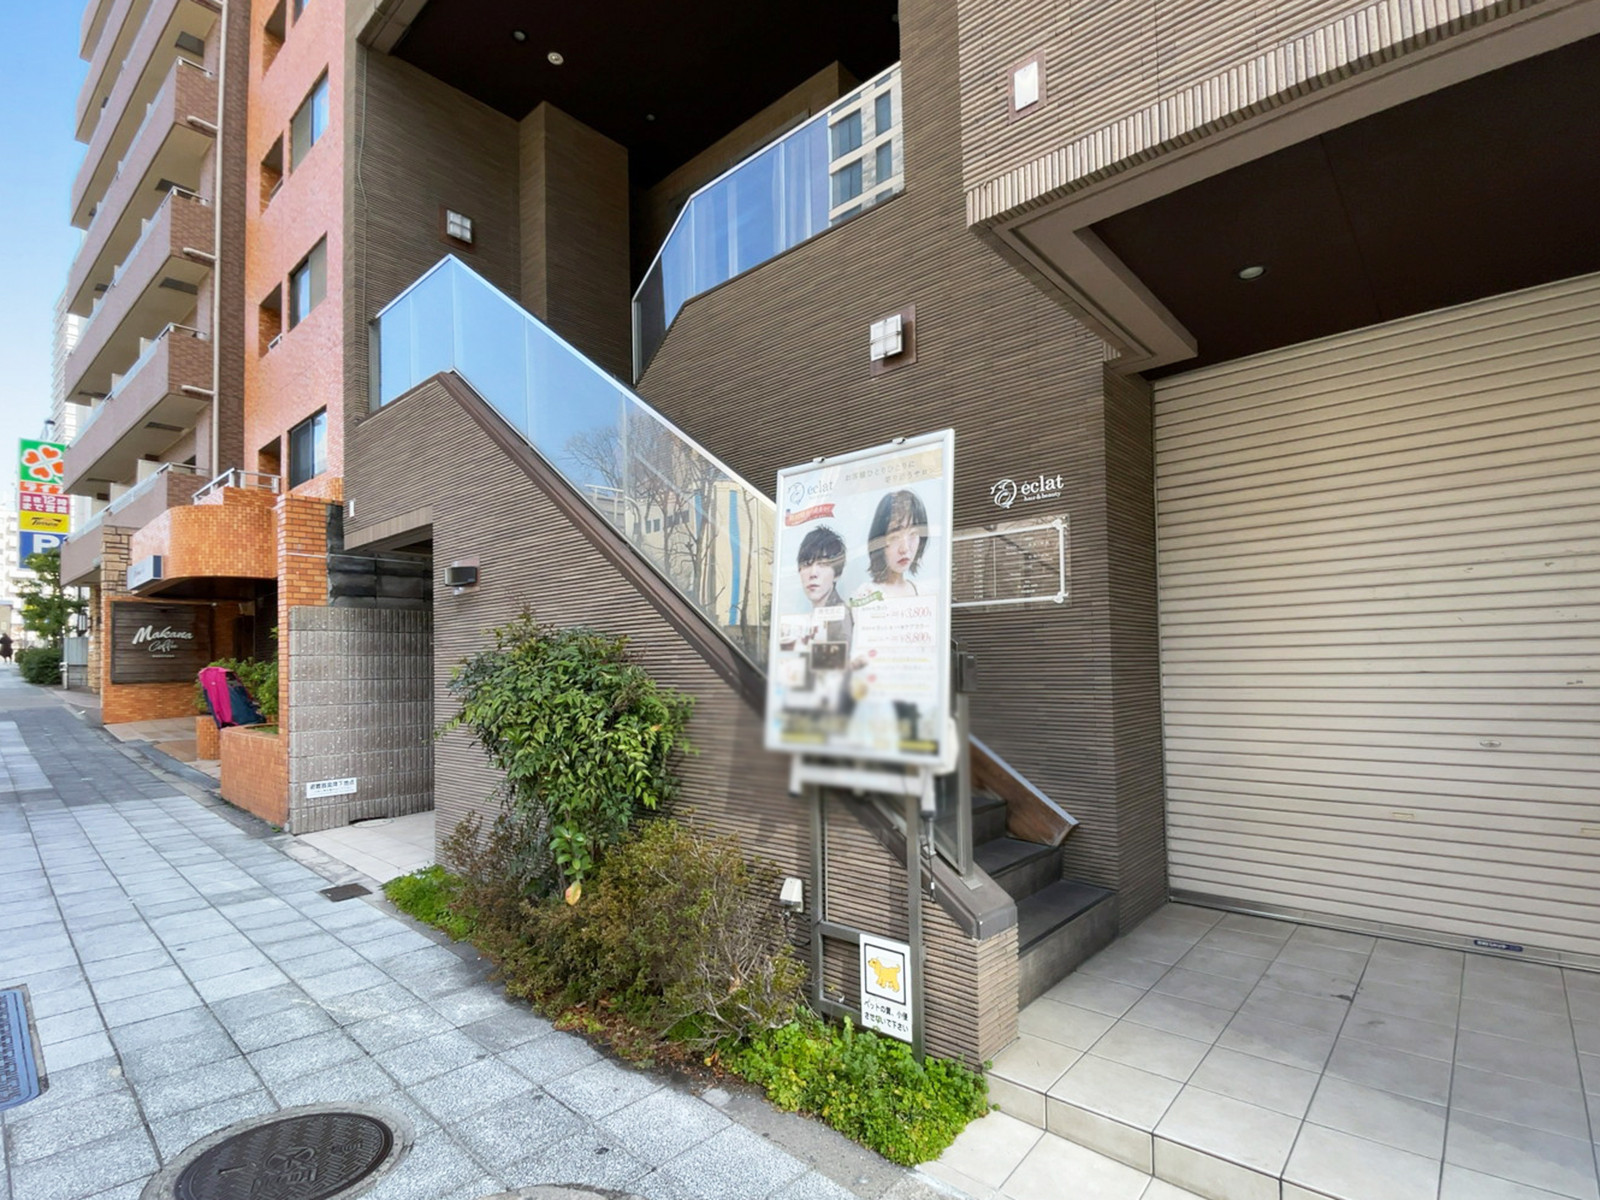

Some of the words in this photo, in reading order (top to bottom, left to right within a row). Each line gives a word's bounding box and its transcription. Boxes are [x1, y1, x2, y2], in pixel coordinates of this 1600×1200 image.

[33, 533, 60, 554] P
[132, 625, 193, 644] Makana
[864, 1011, 909, 1032] させないで下さい
